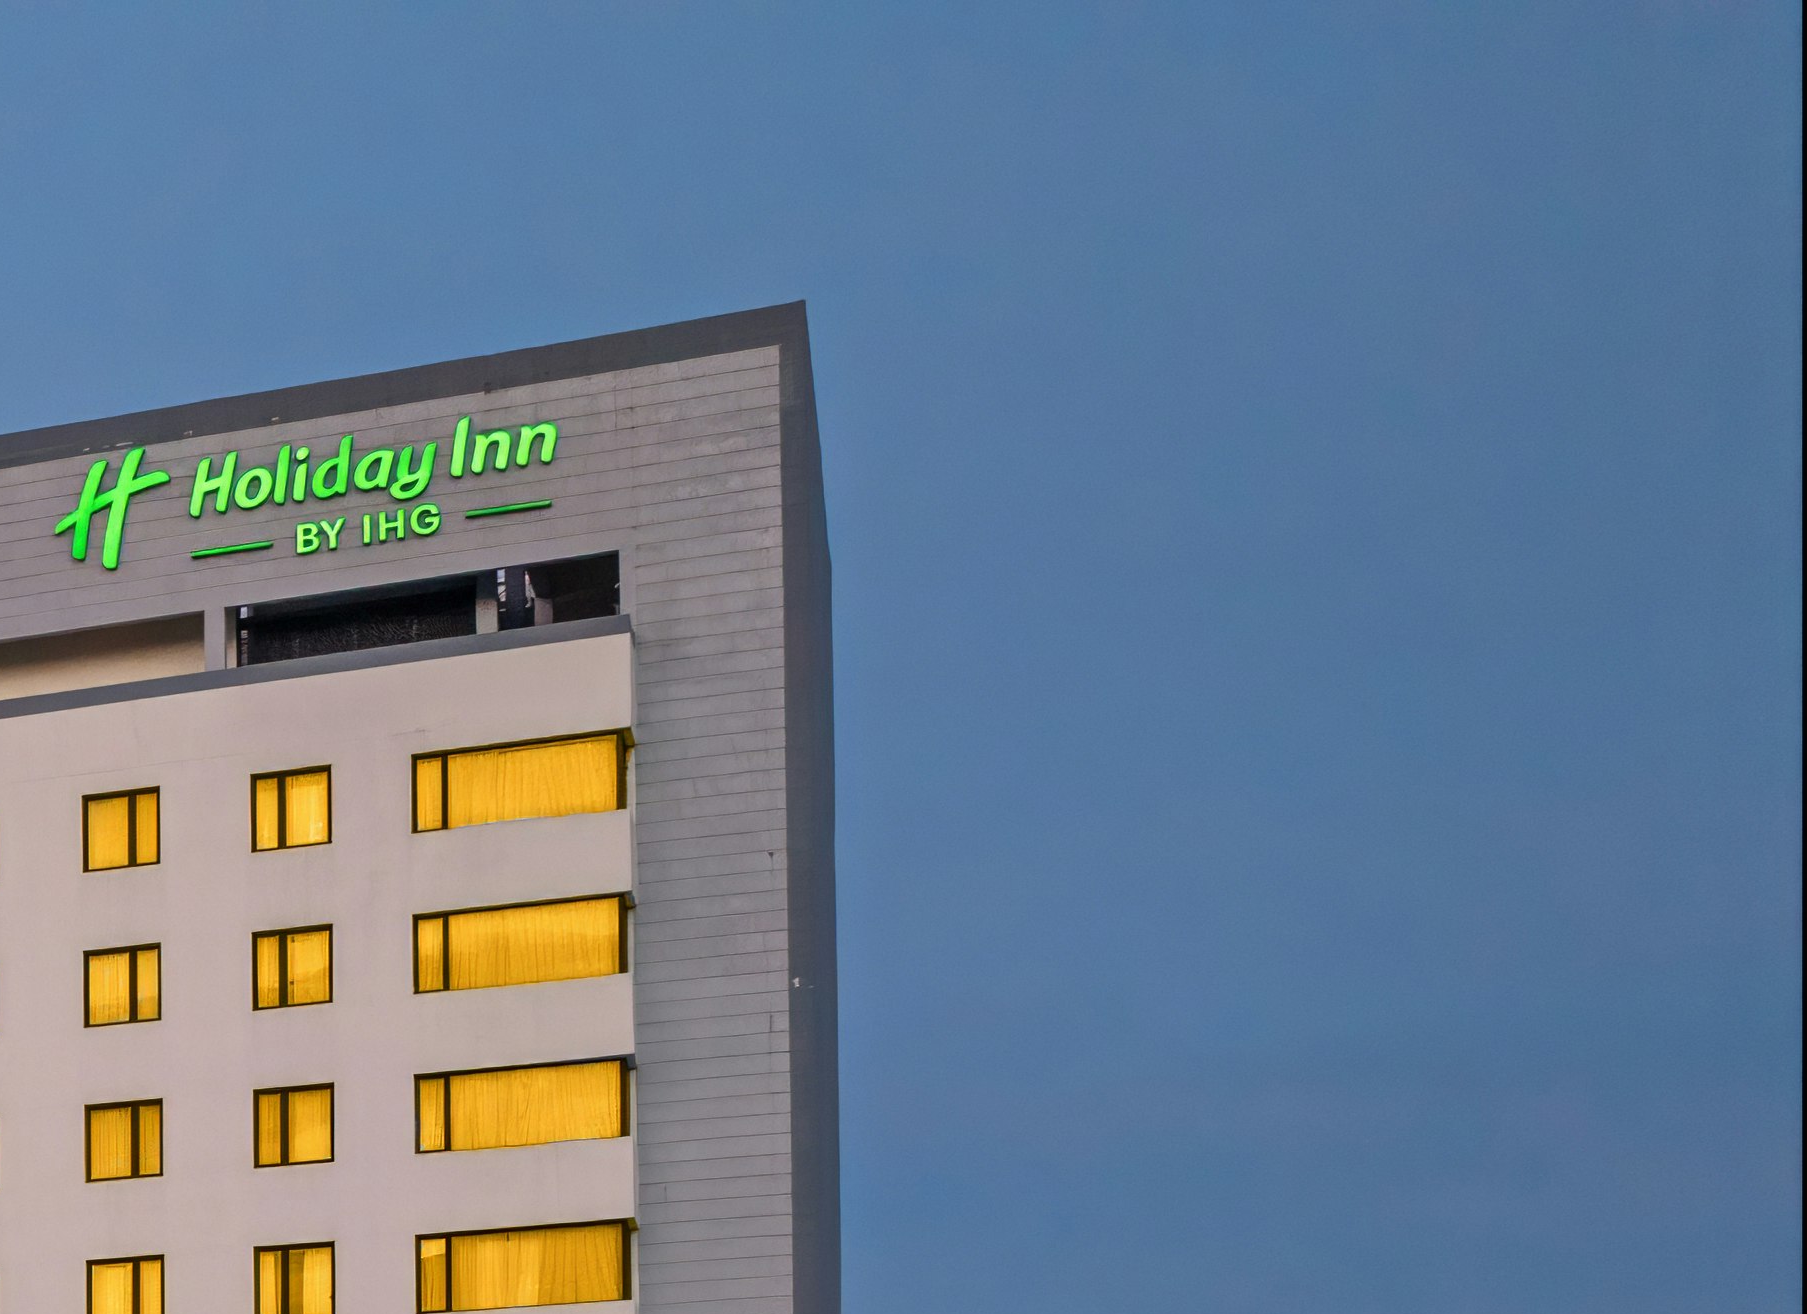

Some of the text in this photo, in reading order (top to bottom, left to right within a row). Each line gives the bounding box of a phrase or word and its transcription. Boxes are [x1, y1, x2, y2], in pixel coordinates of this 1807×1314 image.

[188, 415, 559, 518] Holiday Inn
[295, 502, 442, 556] BY IHG
